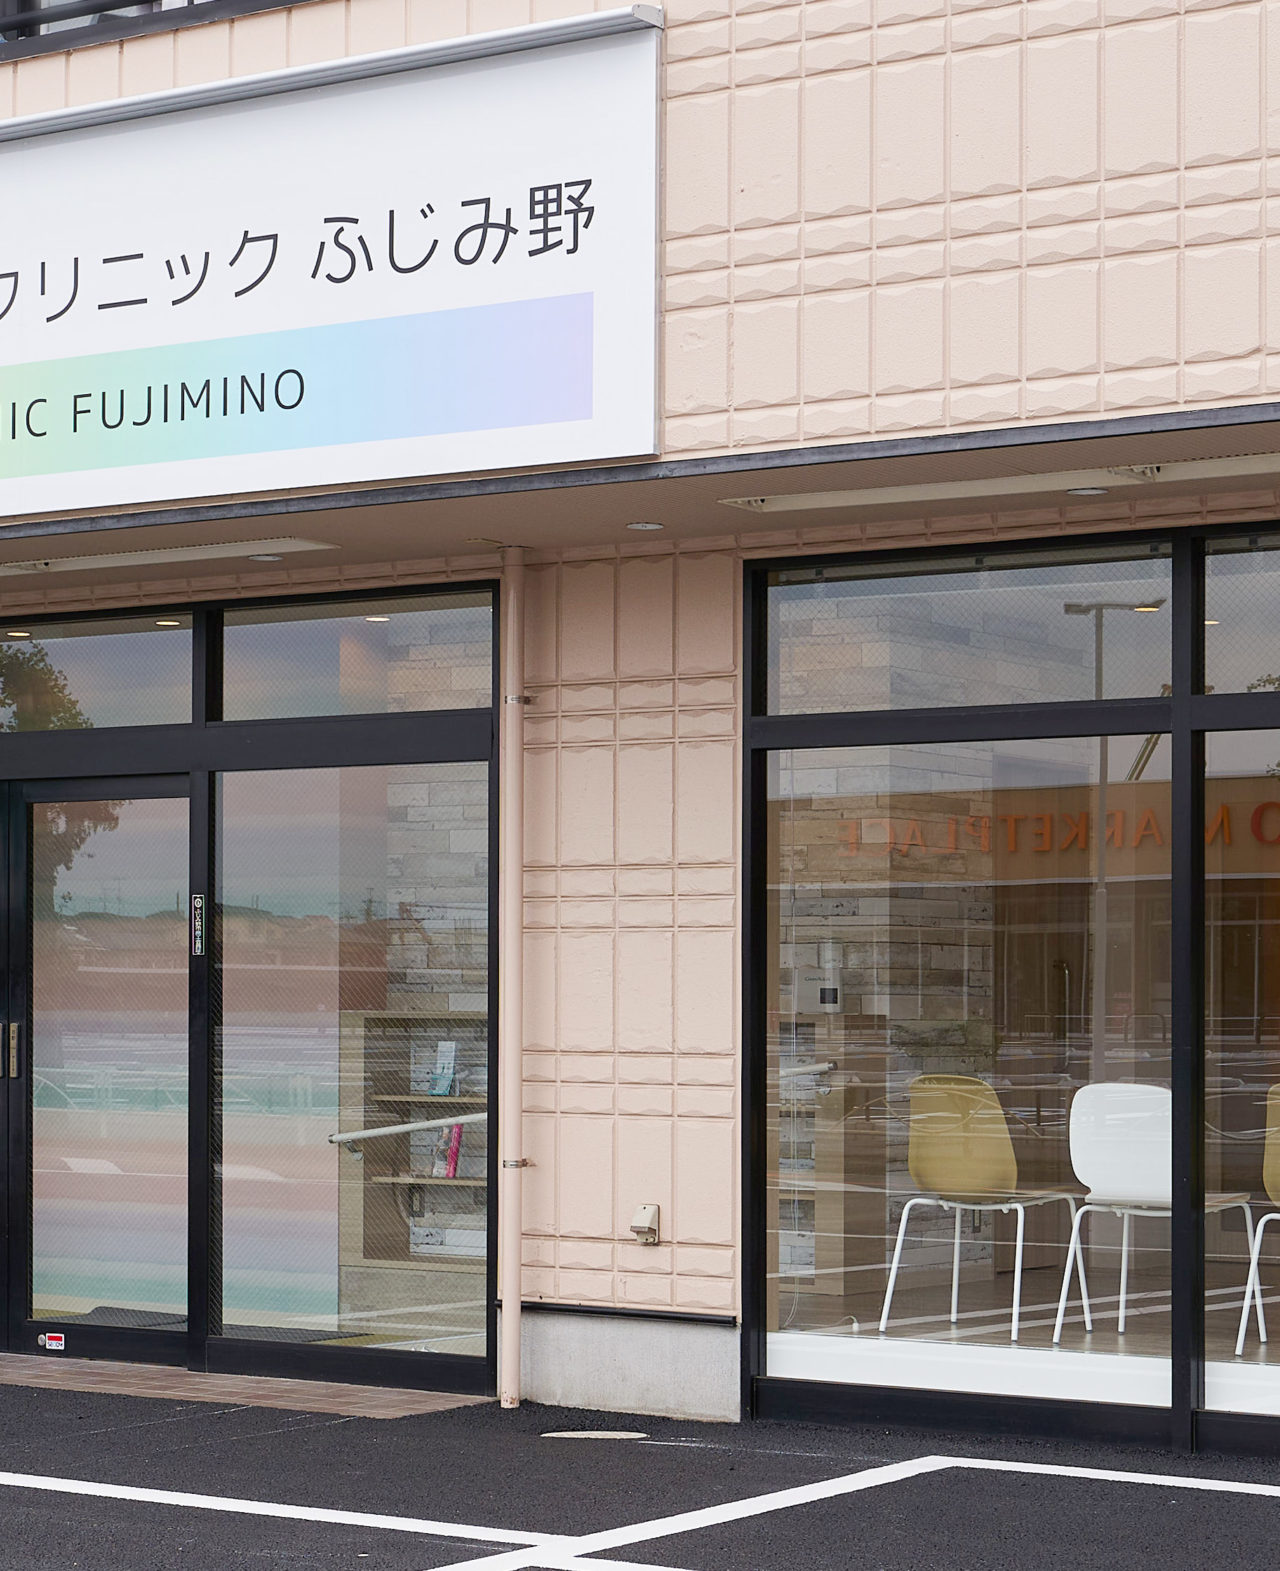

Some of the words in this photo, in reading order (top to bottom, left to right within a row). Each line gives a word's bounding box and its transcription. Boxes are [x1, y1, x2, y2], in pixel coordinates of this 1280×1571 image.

[310, 178, 595, 284] ふじみ野
[73, 369, 305, 433] FUJIMINO
